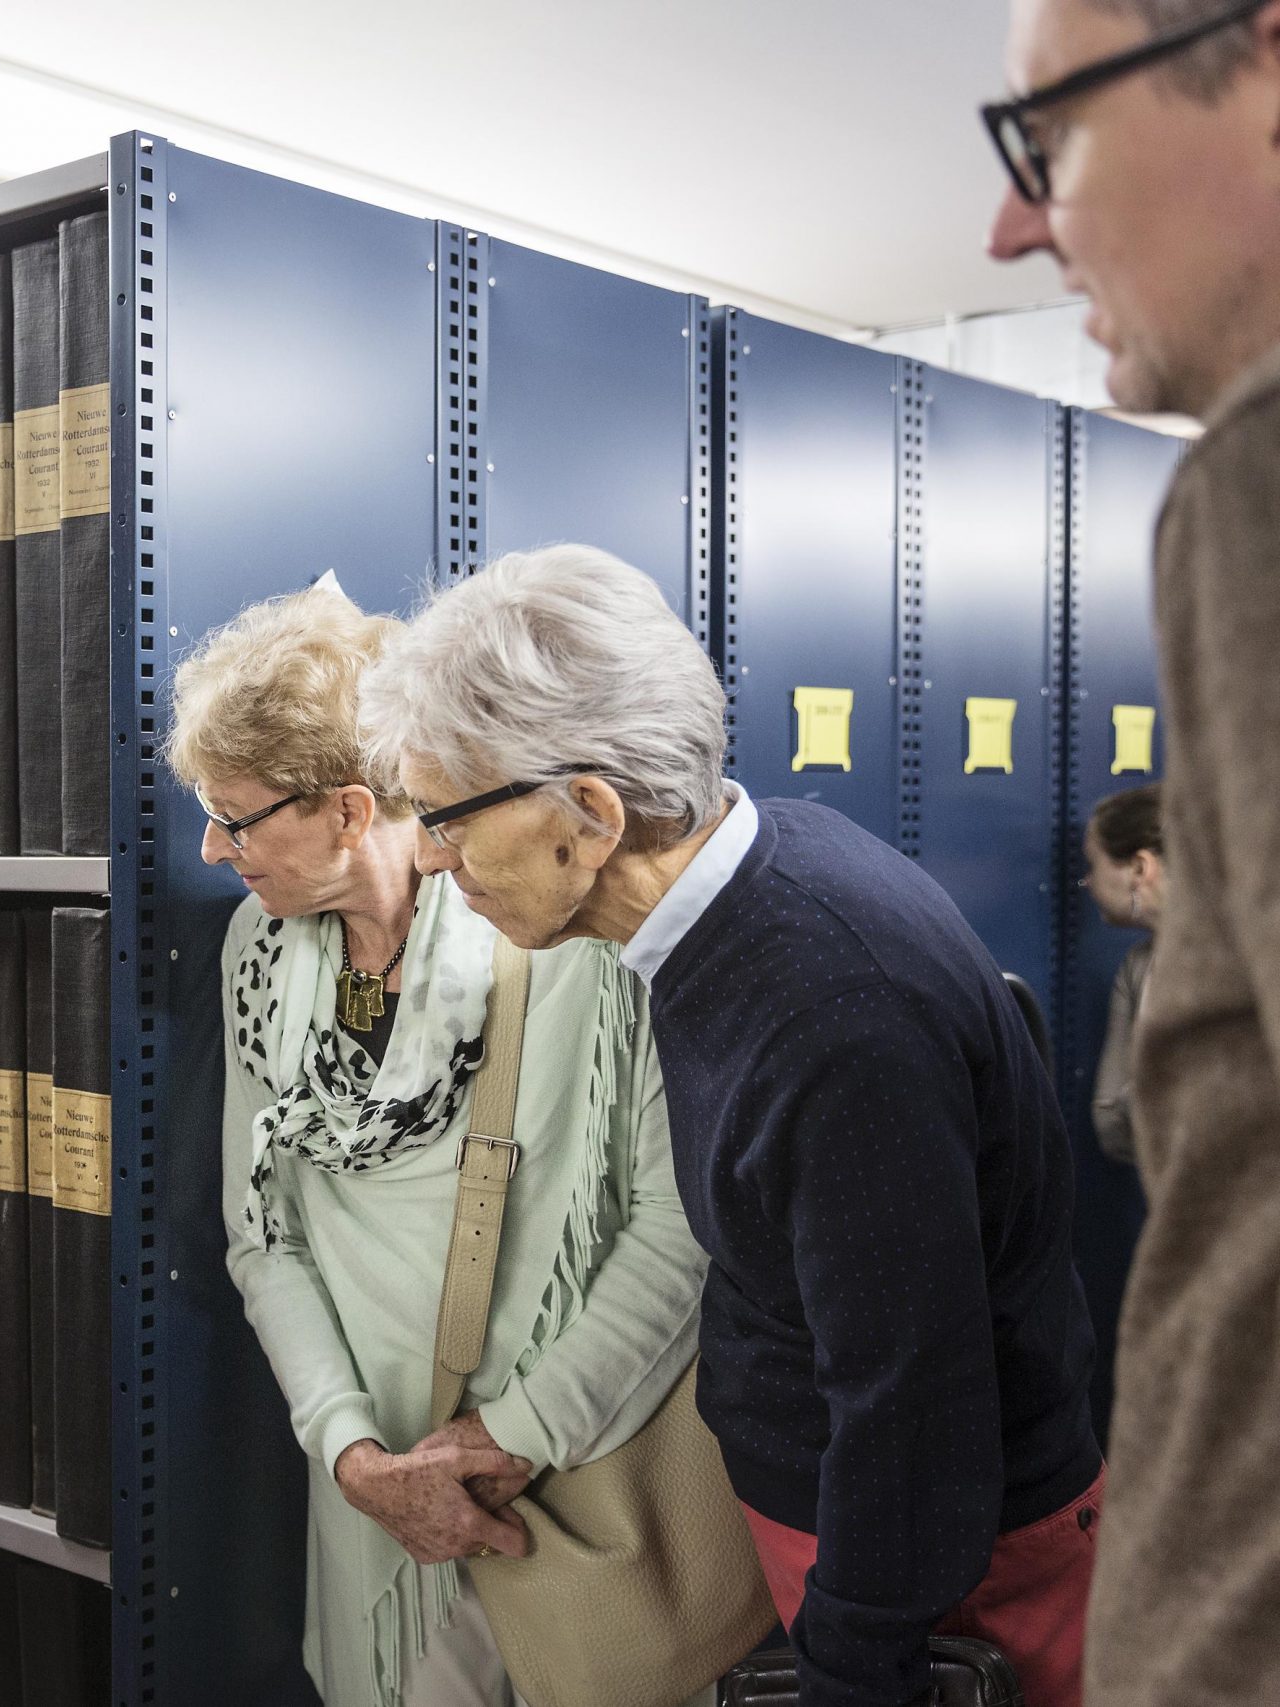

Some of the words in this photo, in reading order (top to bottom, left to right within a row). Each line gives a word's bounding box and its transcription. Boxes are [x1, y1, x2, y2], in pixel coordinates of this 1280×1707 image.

[77, 409, 107, 422] Nieuwe
[29, 430, 58, 442] Nieuwe
[76, 441, 109, 456] Courant
[29, 462, 59, 475] Courant
[84, 459, 100, 468] 1932
[66, 1108, 94, 1124] Nieuwe
[64, 1142, 94, 1158] Courant
